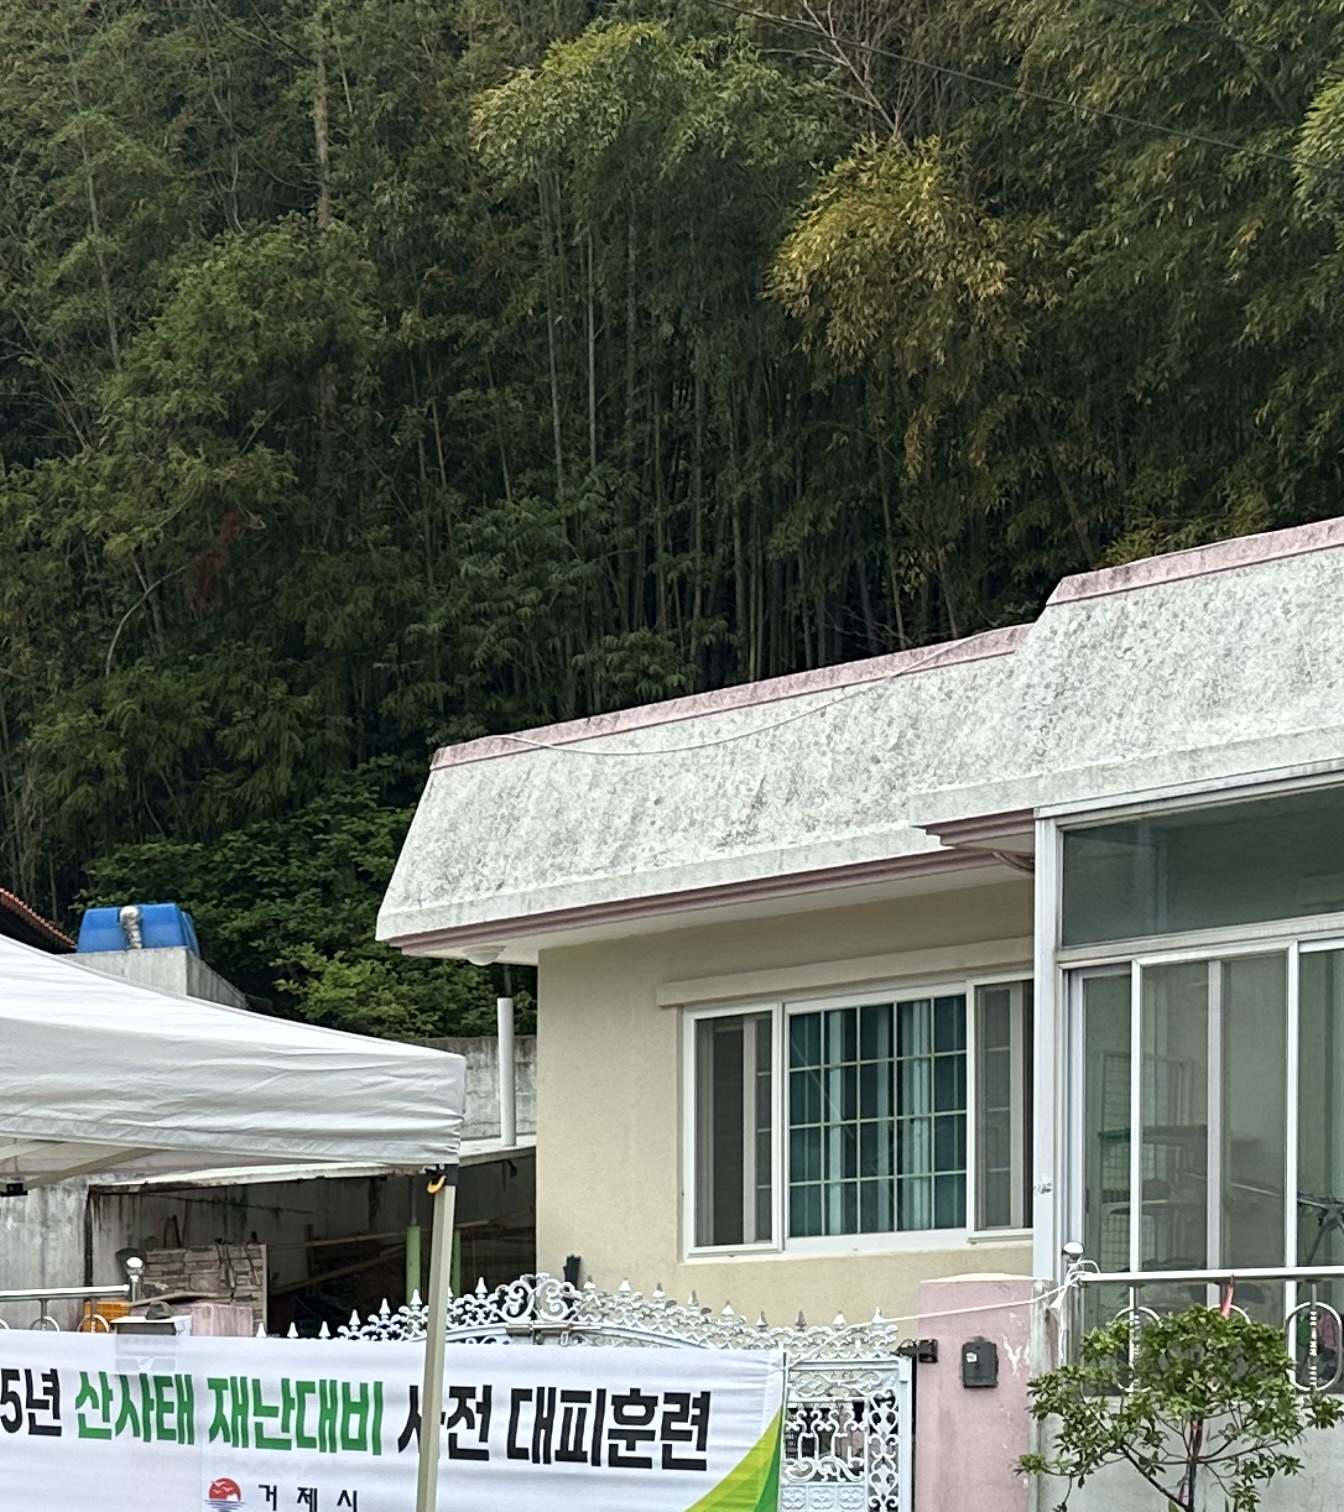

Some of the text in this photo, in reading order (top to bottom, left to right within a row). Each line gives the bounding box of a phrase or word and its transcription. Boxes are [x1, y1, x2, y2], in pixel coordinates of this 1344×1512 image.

[74, 1371, 196, 1446] 산사태
[207, 1376, 384, 1456] 재난대비
[506, 1386, 711, 1471] 대피훈련
